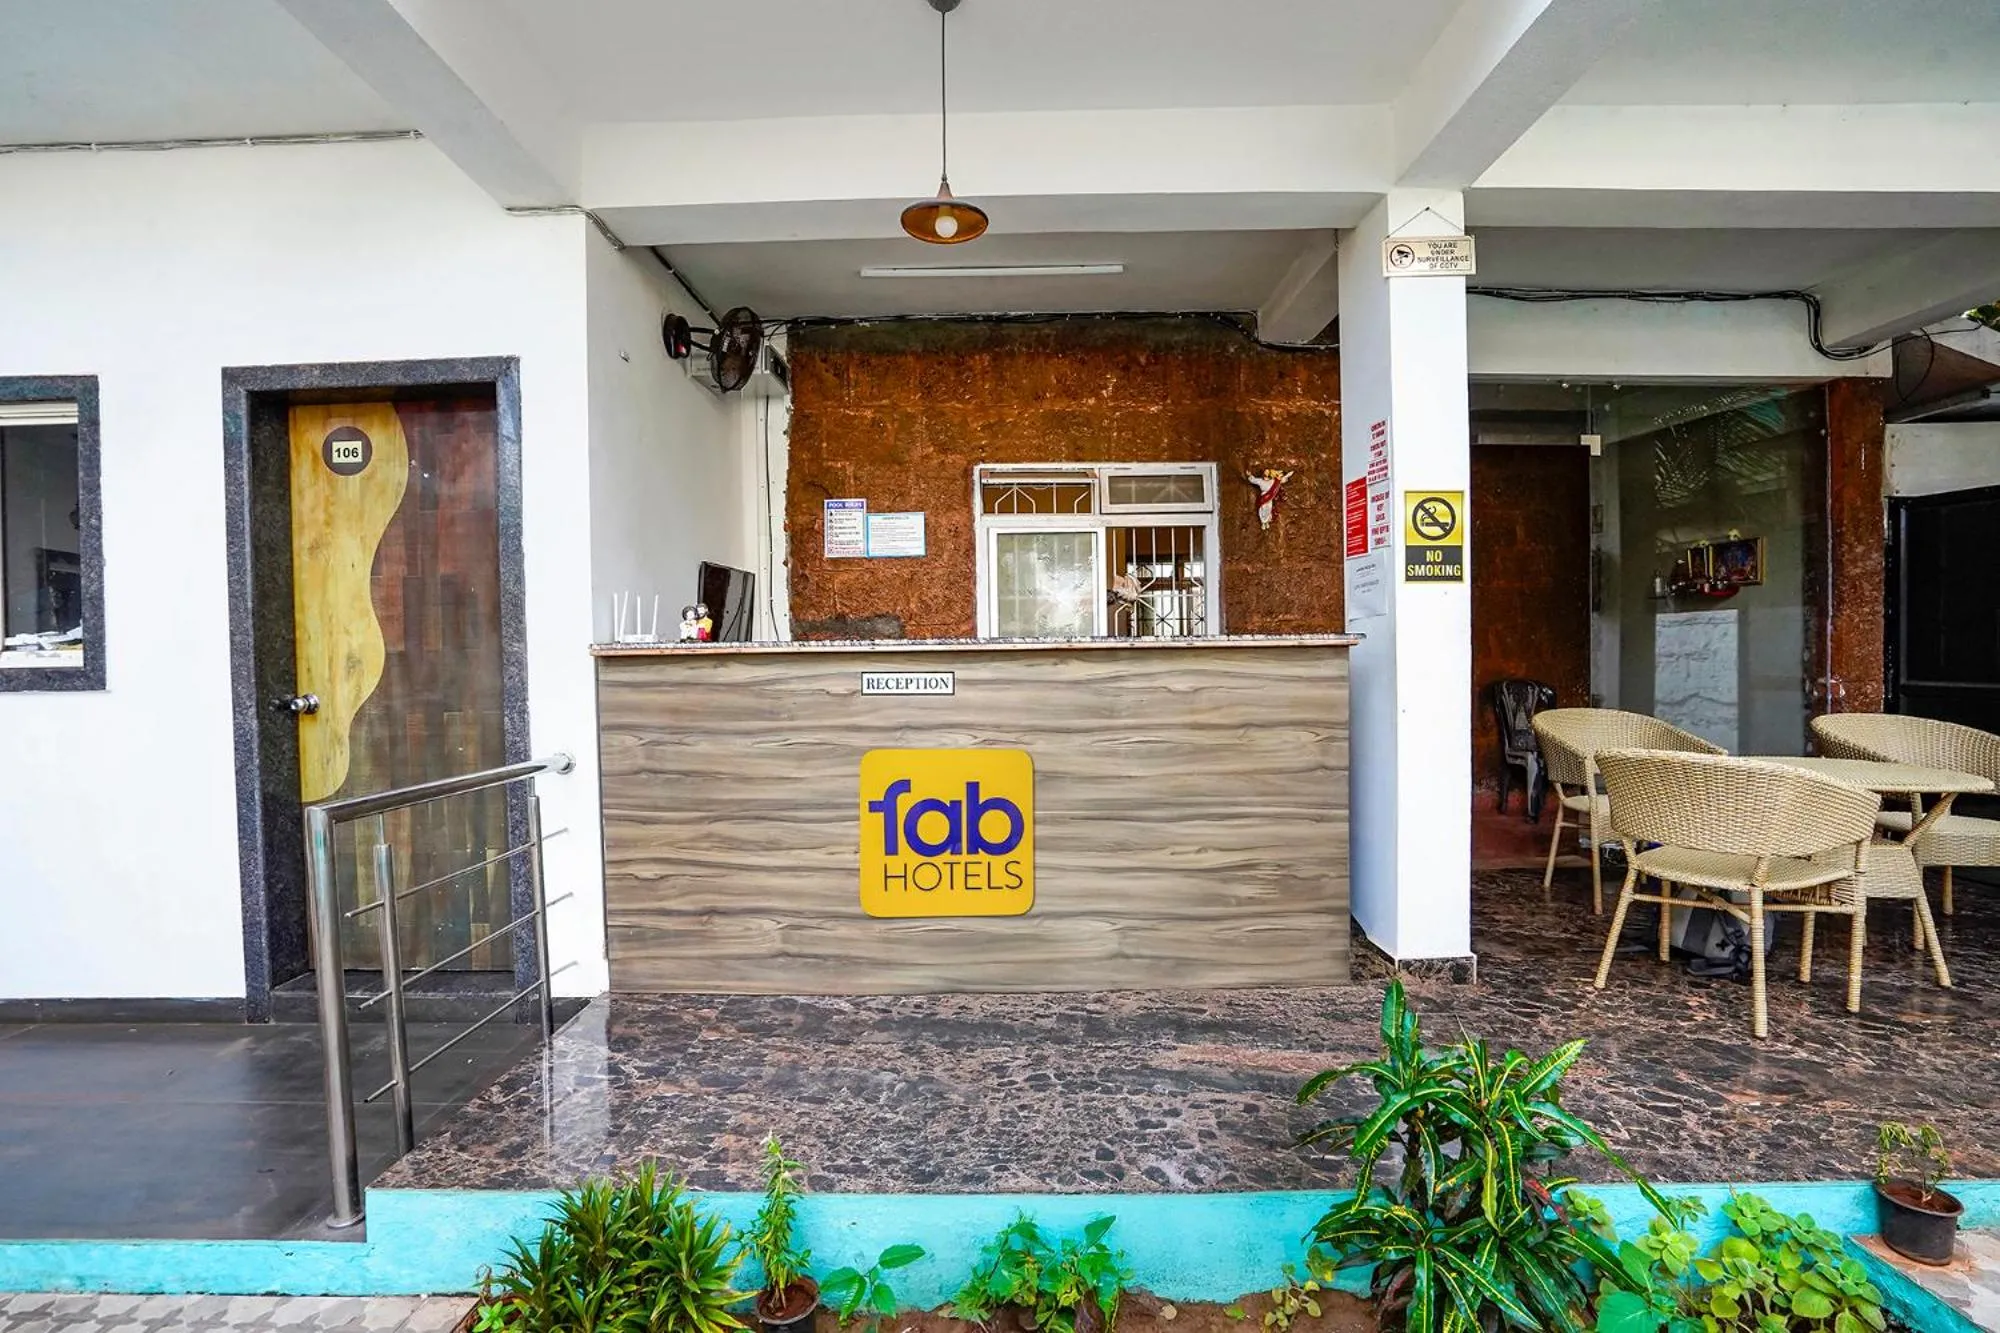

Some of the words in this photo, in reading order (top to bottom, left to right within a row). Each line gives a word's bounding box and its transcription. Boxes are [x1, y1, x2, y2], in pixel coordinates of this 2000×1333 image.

[1417, 255, 1469, 263] SURVEILLANCE
[335, 447, 359, 458] 106
[1426, 550, 1442, 562] NO
[1407, 564, 1461, 577] SMOKING
[866, 677, 949, 690] RECEPTION
[868, 779, 1025, 857] fab
[884, 860, 1023, 892] HOTELS
